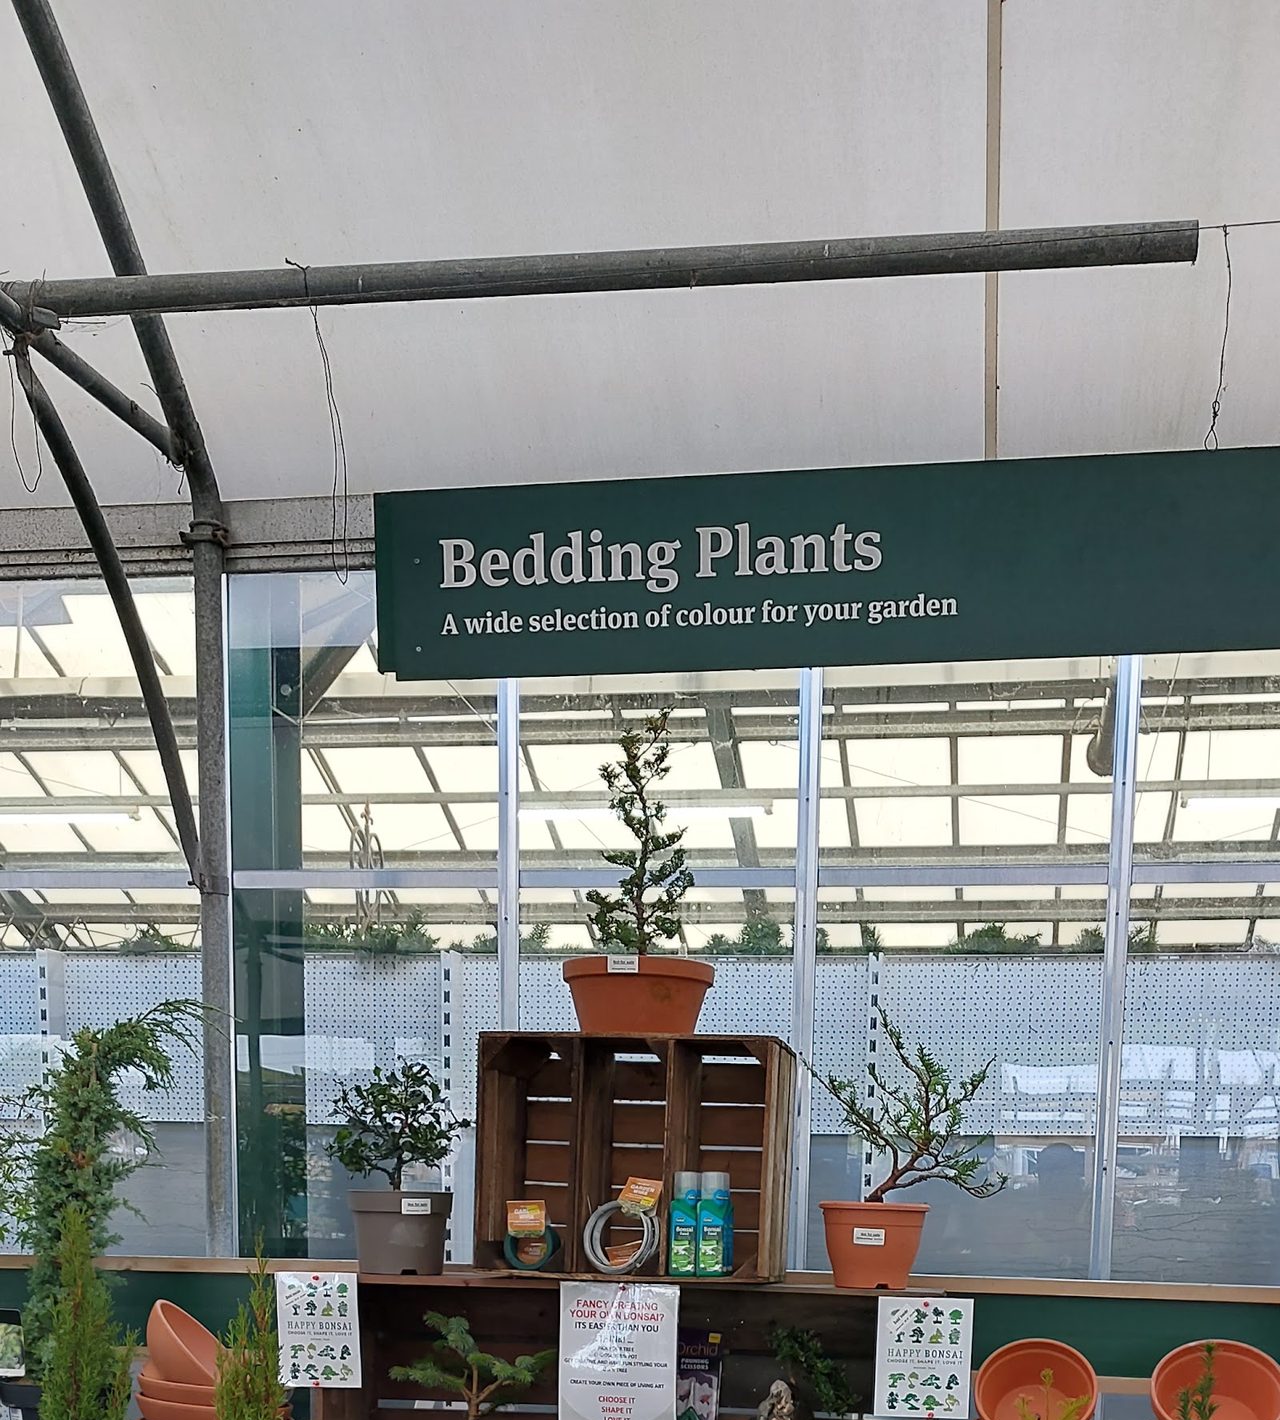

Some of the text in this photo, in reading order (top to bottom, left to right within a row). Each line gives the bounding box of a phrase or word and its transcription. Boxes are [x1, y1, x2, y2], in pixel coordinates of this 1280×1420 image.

[439, 522, 883, 593] Bedding Plants
[441, 593, 958, 635] A wide selection of colour for your garden
[576, 1299, 609, 1309] FANCY
[570, 1309, 597, 1319] YOUR
[599, 1311, 622, 1320] ON
[287, 1321, 352, 1331] HAPPY BONSAI
[575, 1321, 586, 1329] ITS
[641, 1325, 659, 1333] YOU
[678, 1341, 718, 1356] Orchid
[888, 1348, 963, 1359] HAPPY BONSAI
[598, 1395, 628, 1404] CHOOSE
[601, 1406, 624, 1414] SHAPE
